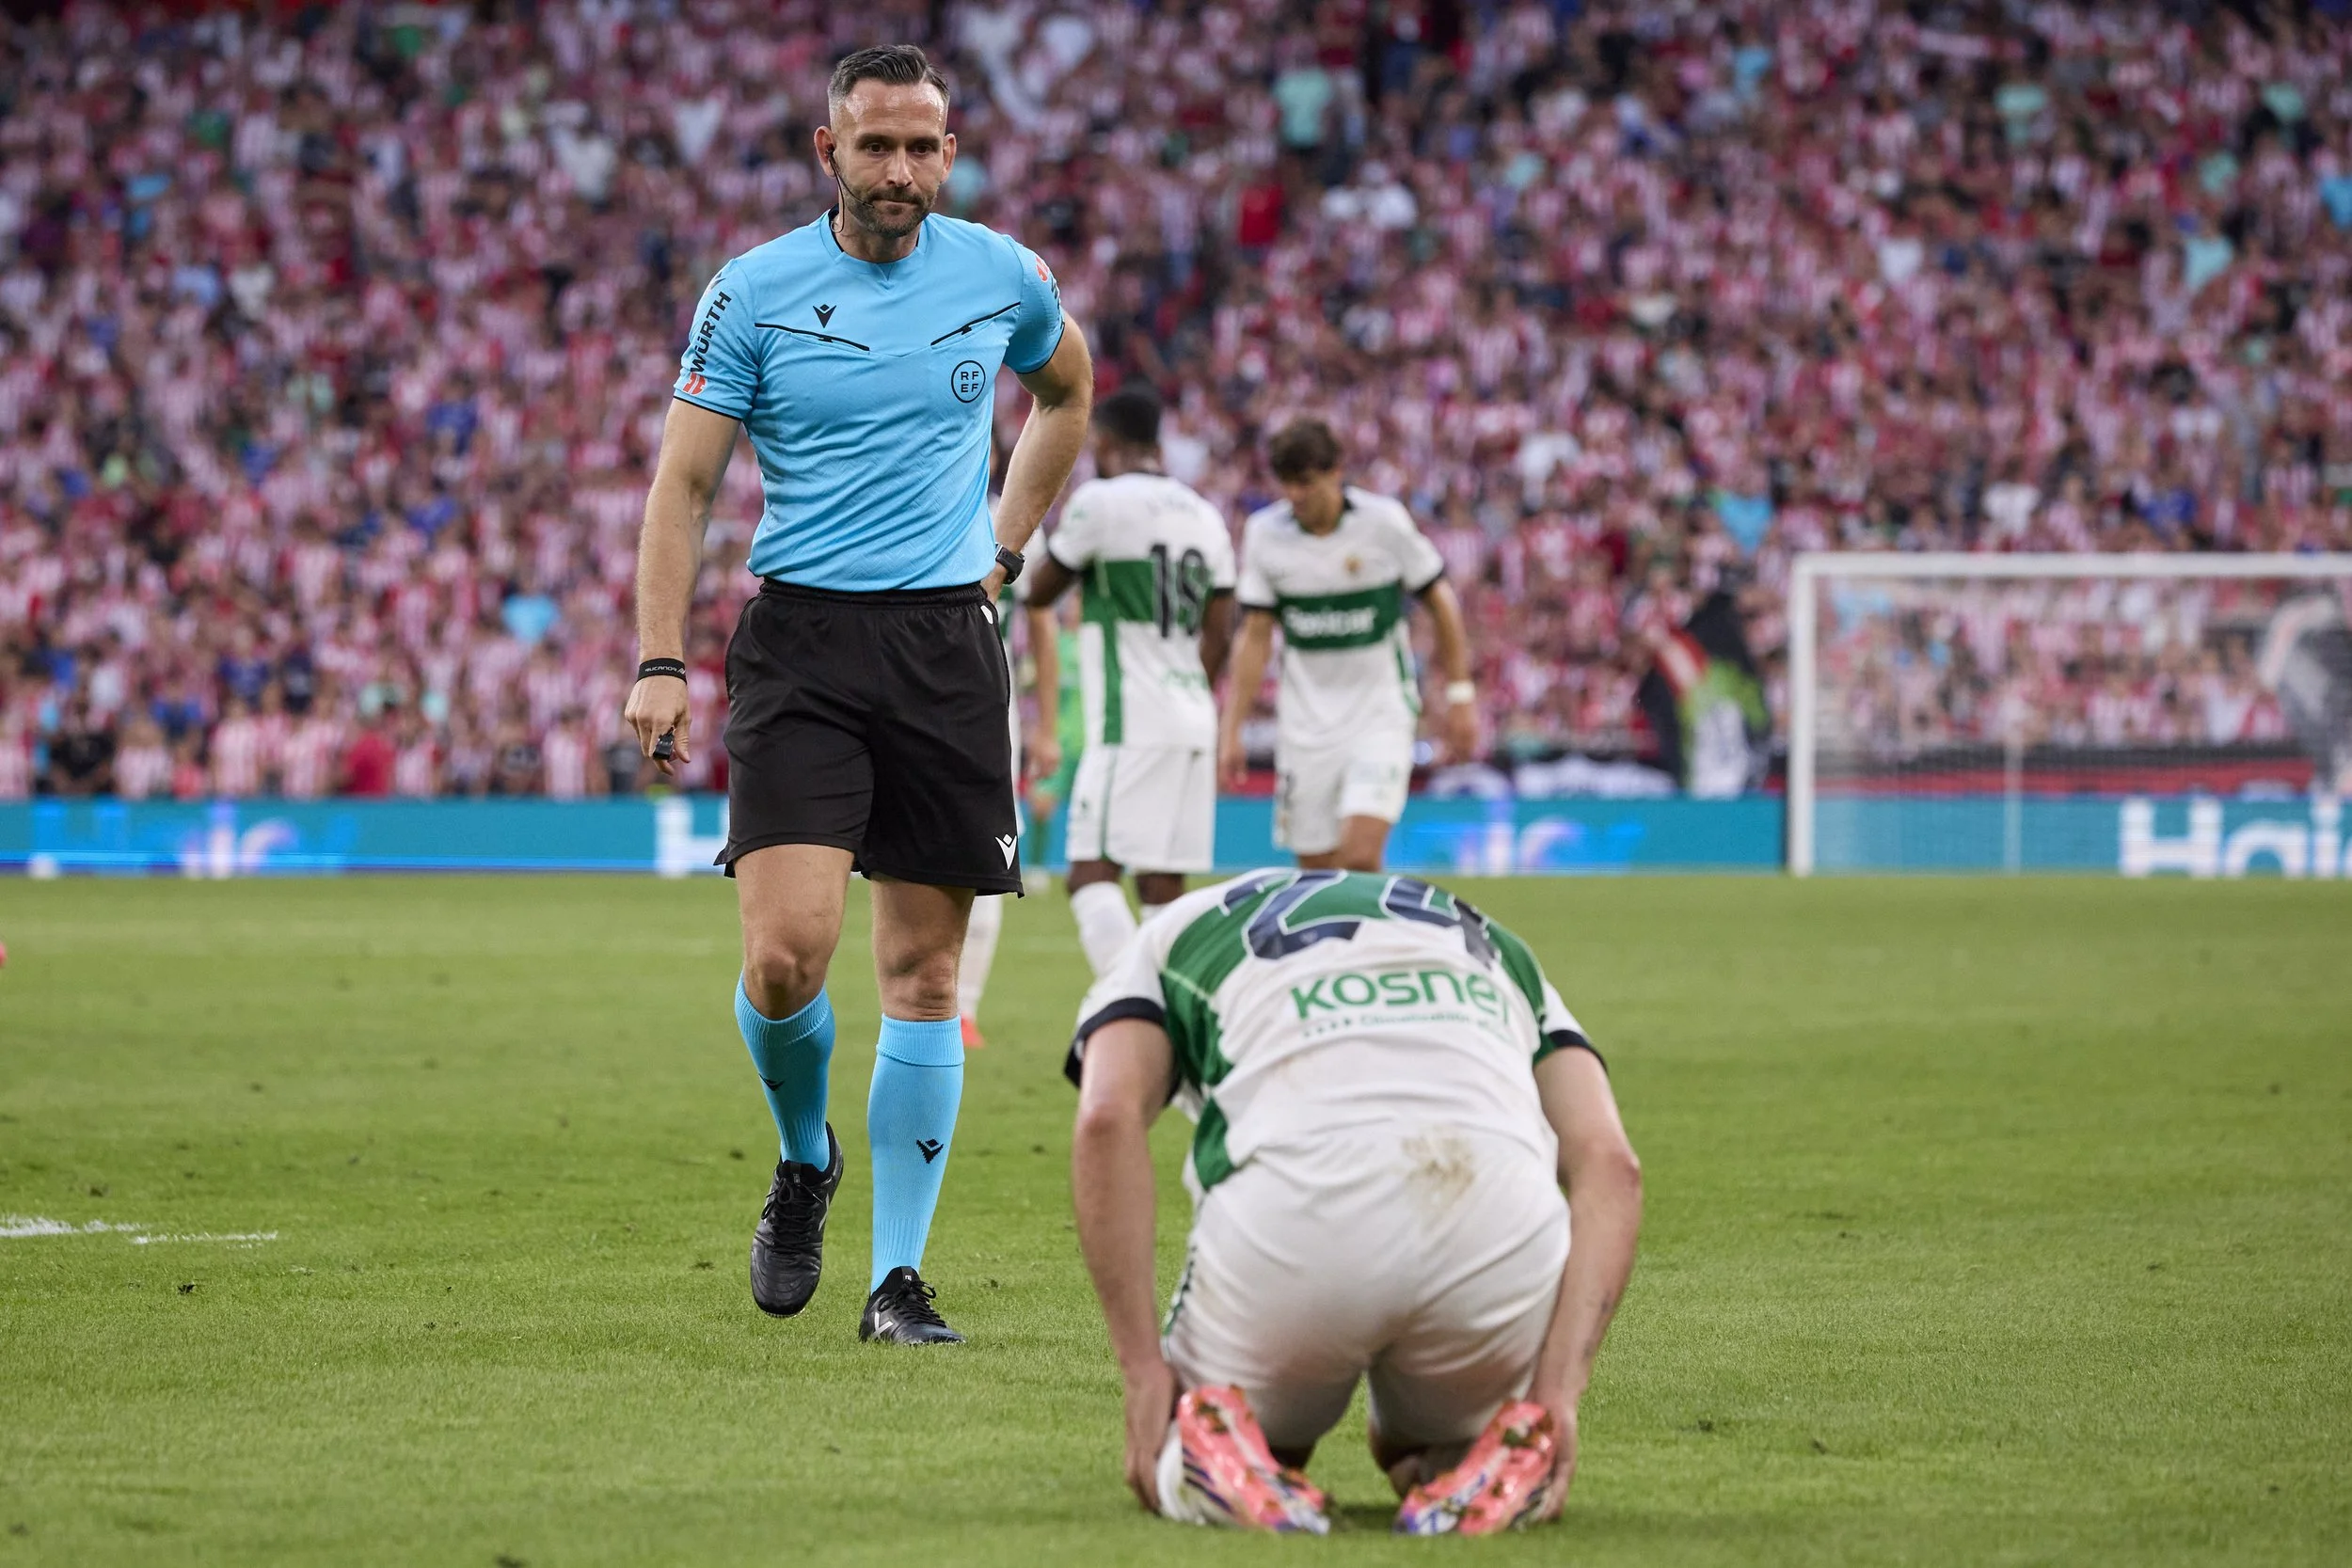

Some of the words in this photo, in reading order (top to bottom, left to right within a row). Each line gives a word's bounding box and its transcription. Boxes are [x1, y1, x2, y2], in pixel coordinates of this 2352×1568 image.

[690, 291, 732, 372] WÜRTH
[961, 371, 979, 381] RF
[961, 383, 979, 393] EF
[2120, 795, 2352, 880] Hai
